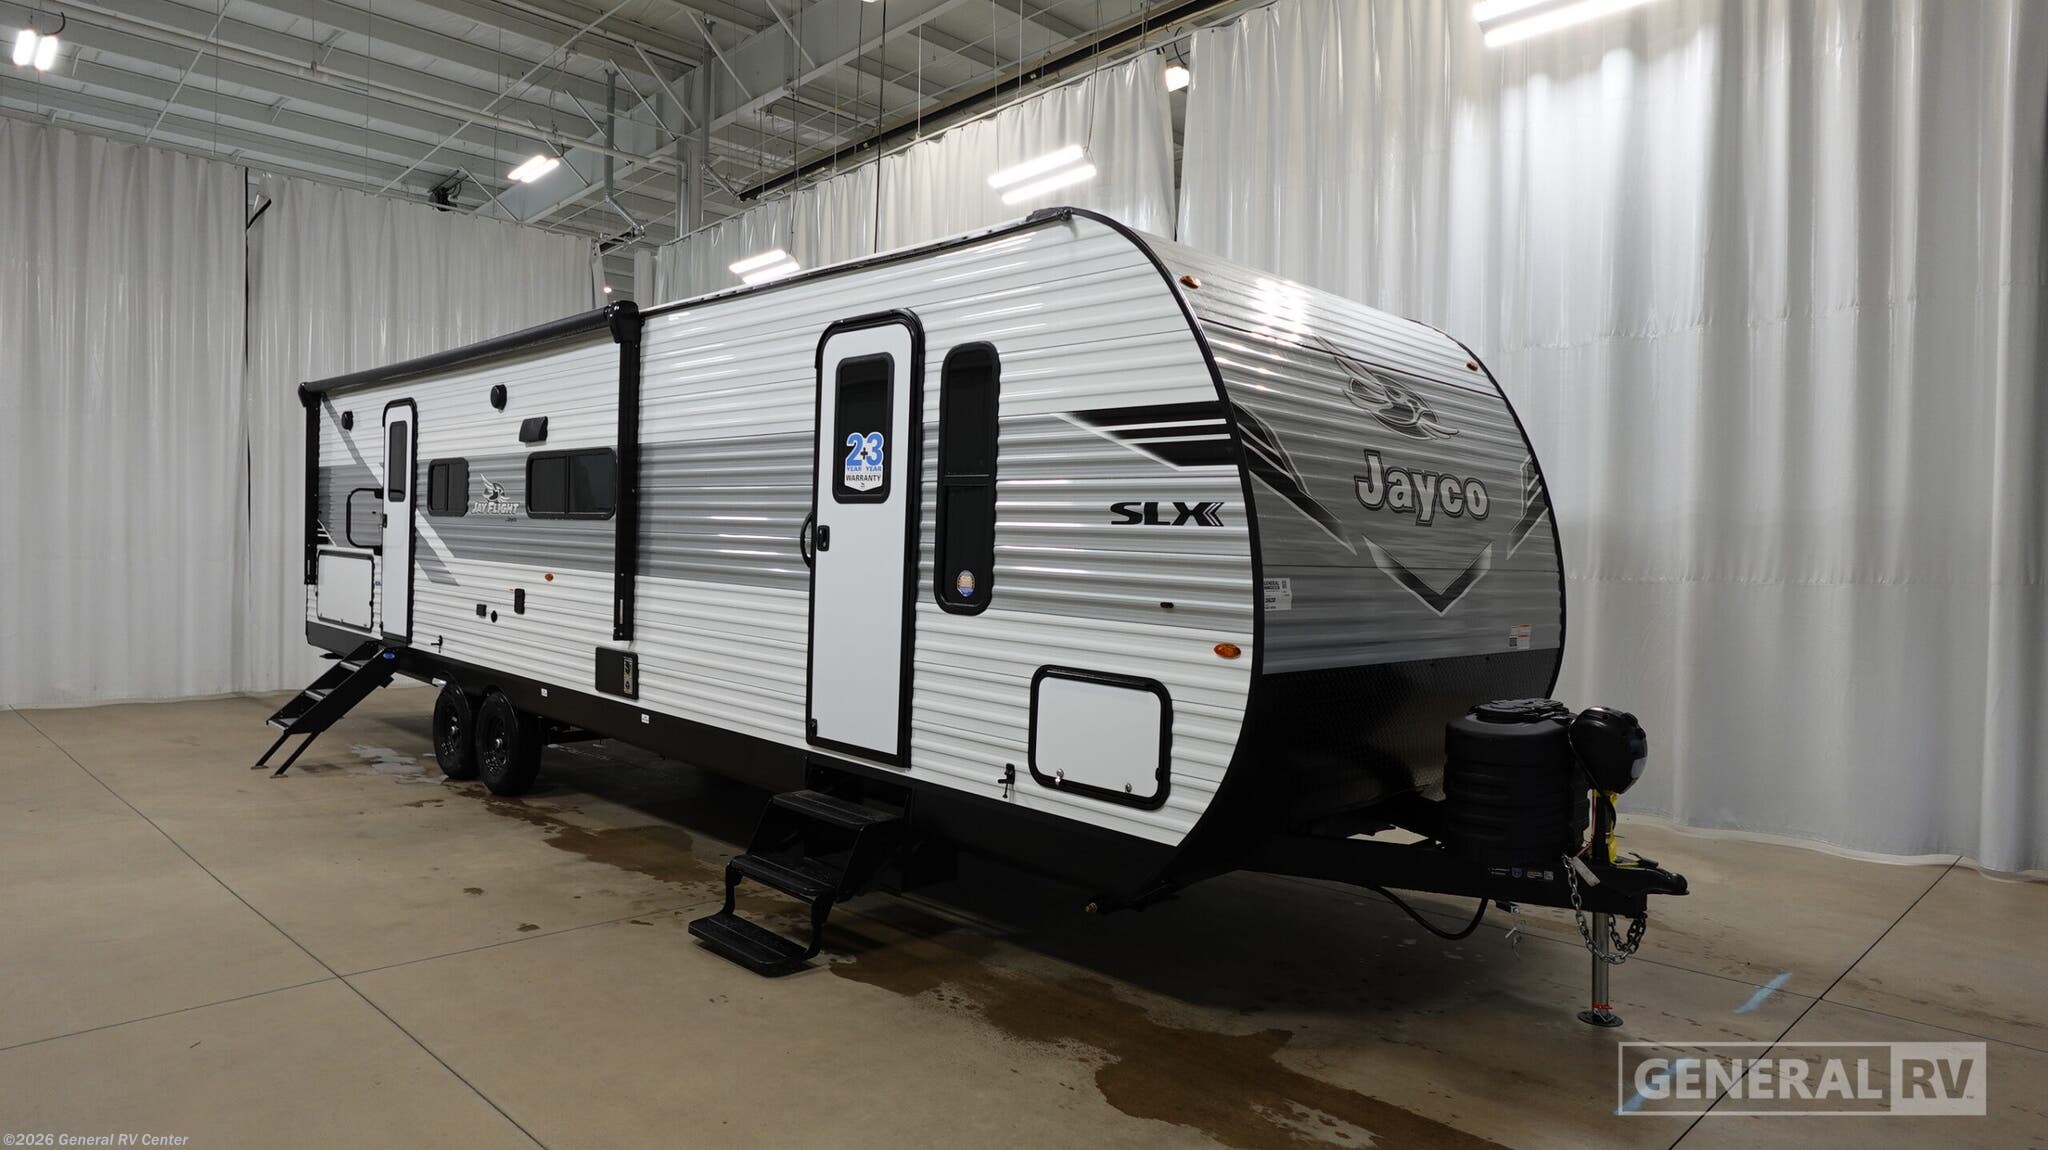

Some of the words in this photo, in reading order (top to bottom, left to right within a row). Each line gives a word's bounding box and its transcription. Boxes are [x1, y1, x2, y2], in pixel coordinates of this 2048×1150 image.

[1354, 449, 1490, 527] Jayco
[472, 503, 487, 513] JAY
[488, 502, 519, 514] FLIGHT
[1110, 501, 1225, 527] SLX
